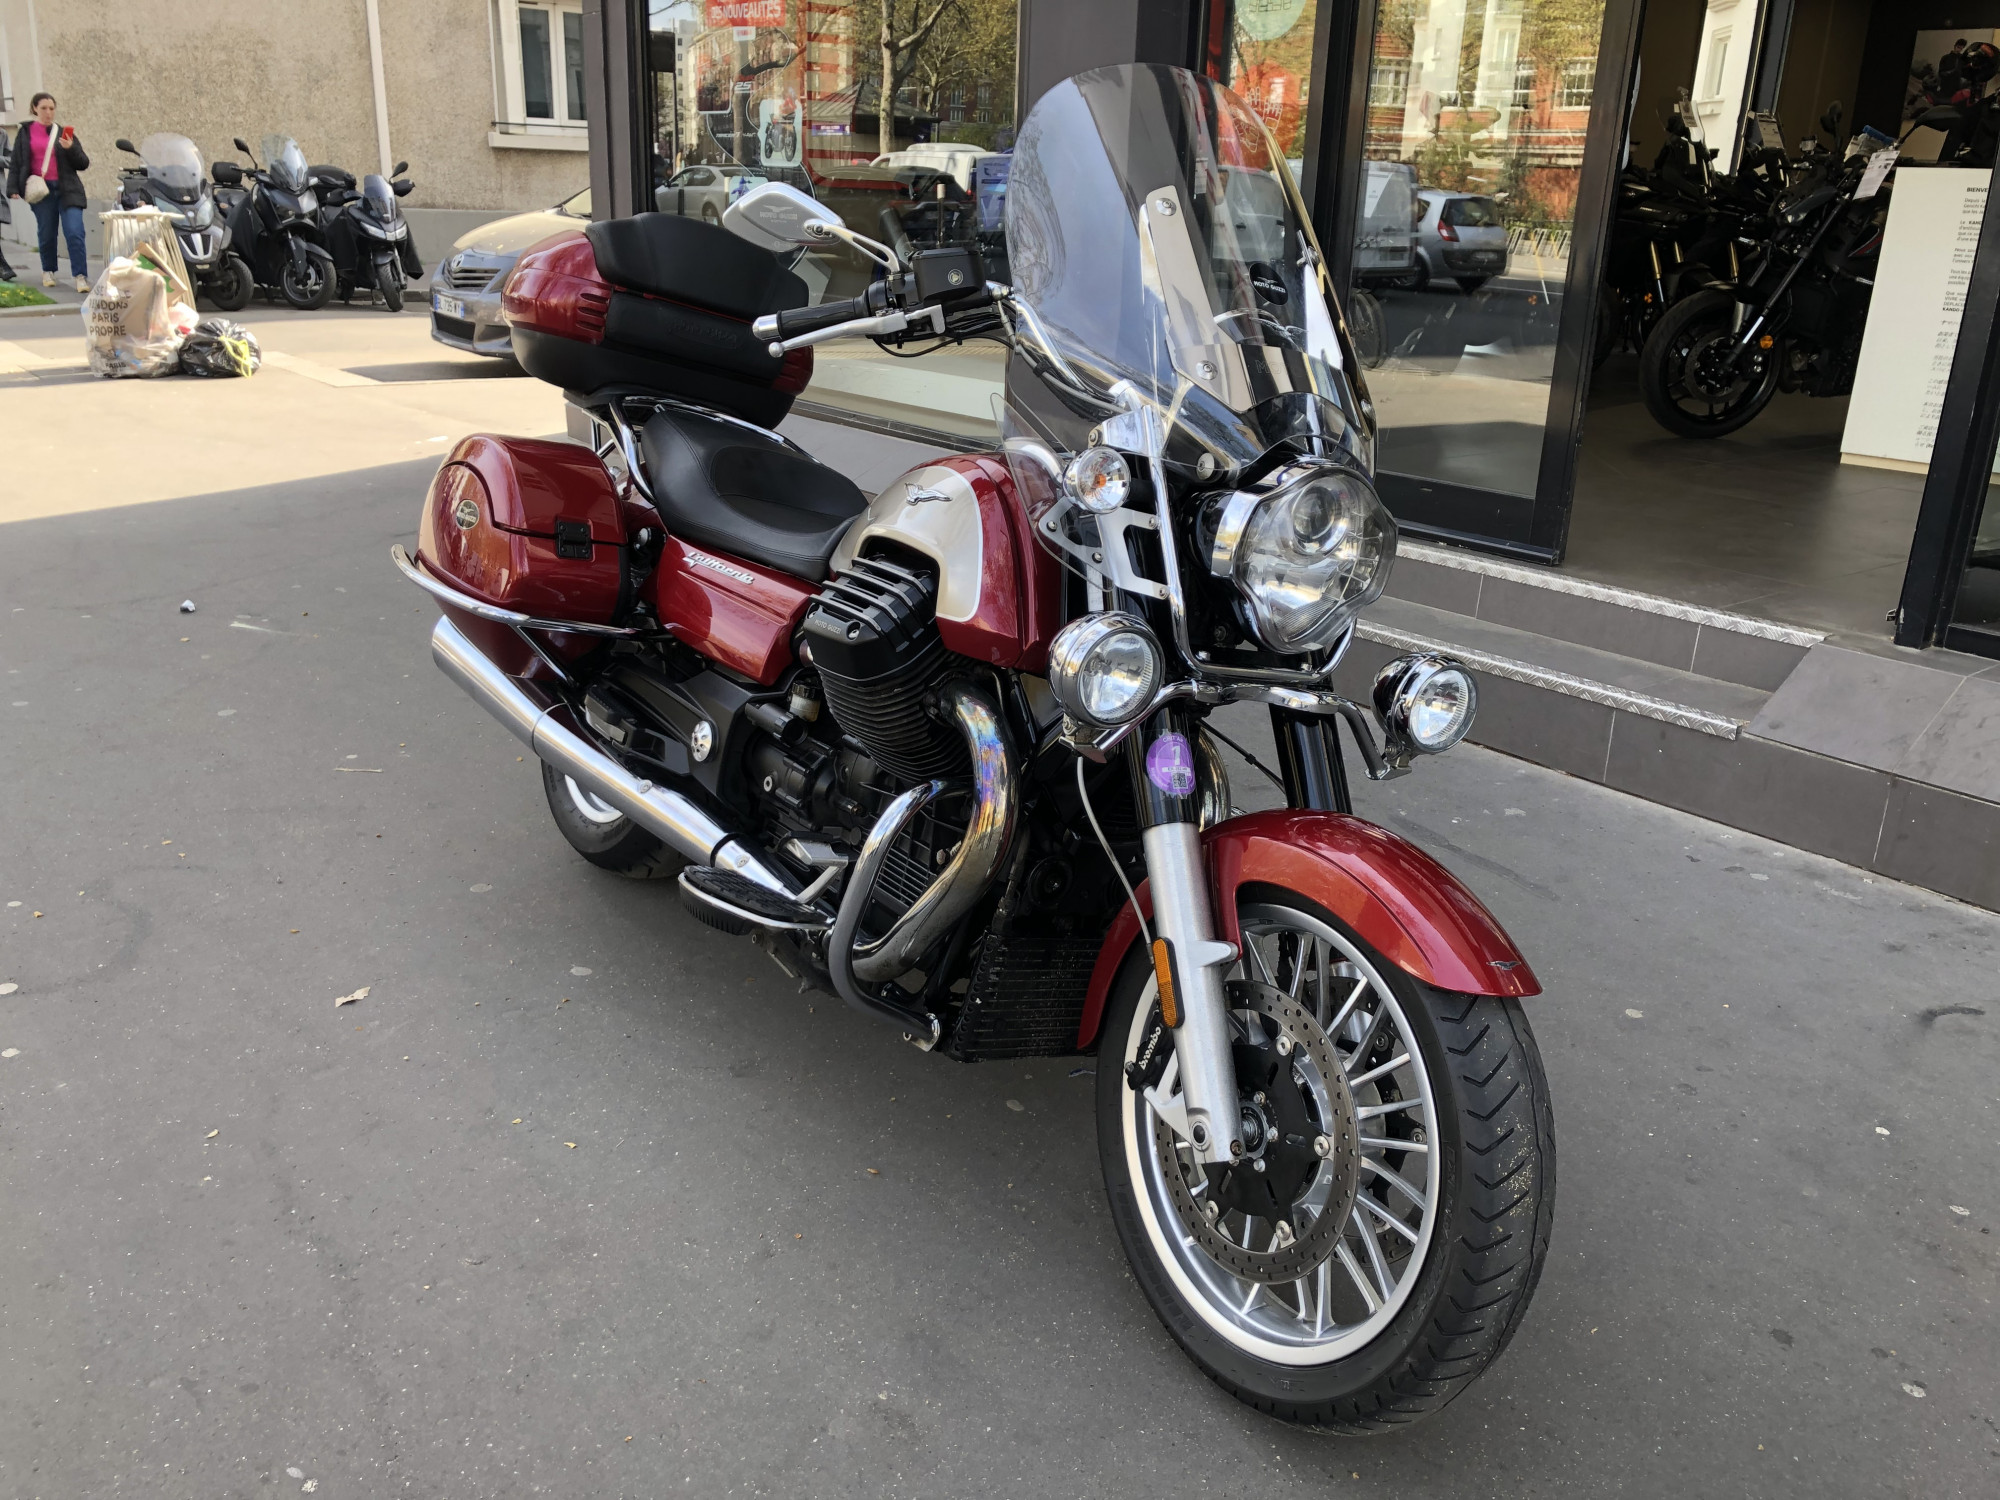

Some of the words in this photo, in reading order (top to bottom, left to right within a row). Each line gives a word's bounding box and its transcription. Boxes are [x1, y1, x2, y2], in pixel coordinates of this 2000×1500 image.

[1253, 280, 1270, 288] MOTO
[92, 312, 120, 323] PARIS
[89, 325, 127, 337] PROPRE
[682, 551, 755, 585] California
[814, 619, 828, 629] MOTO
[827, 624, 842, 634] GUZZI
[1171, 745, 1181, 766] 1
[1138, 1026, 1162, 1070] brembo
